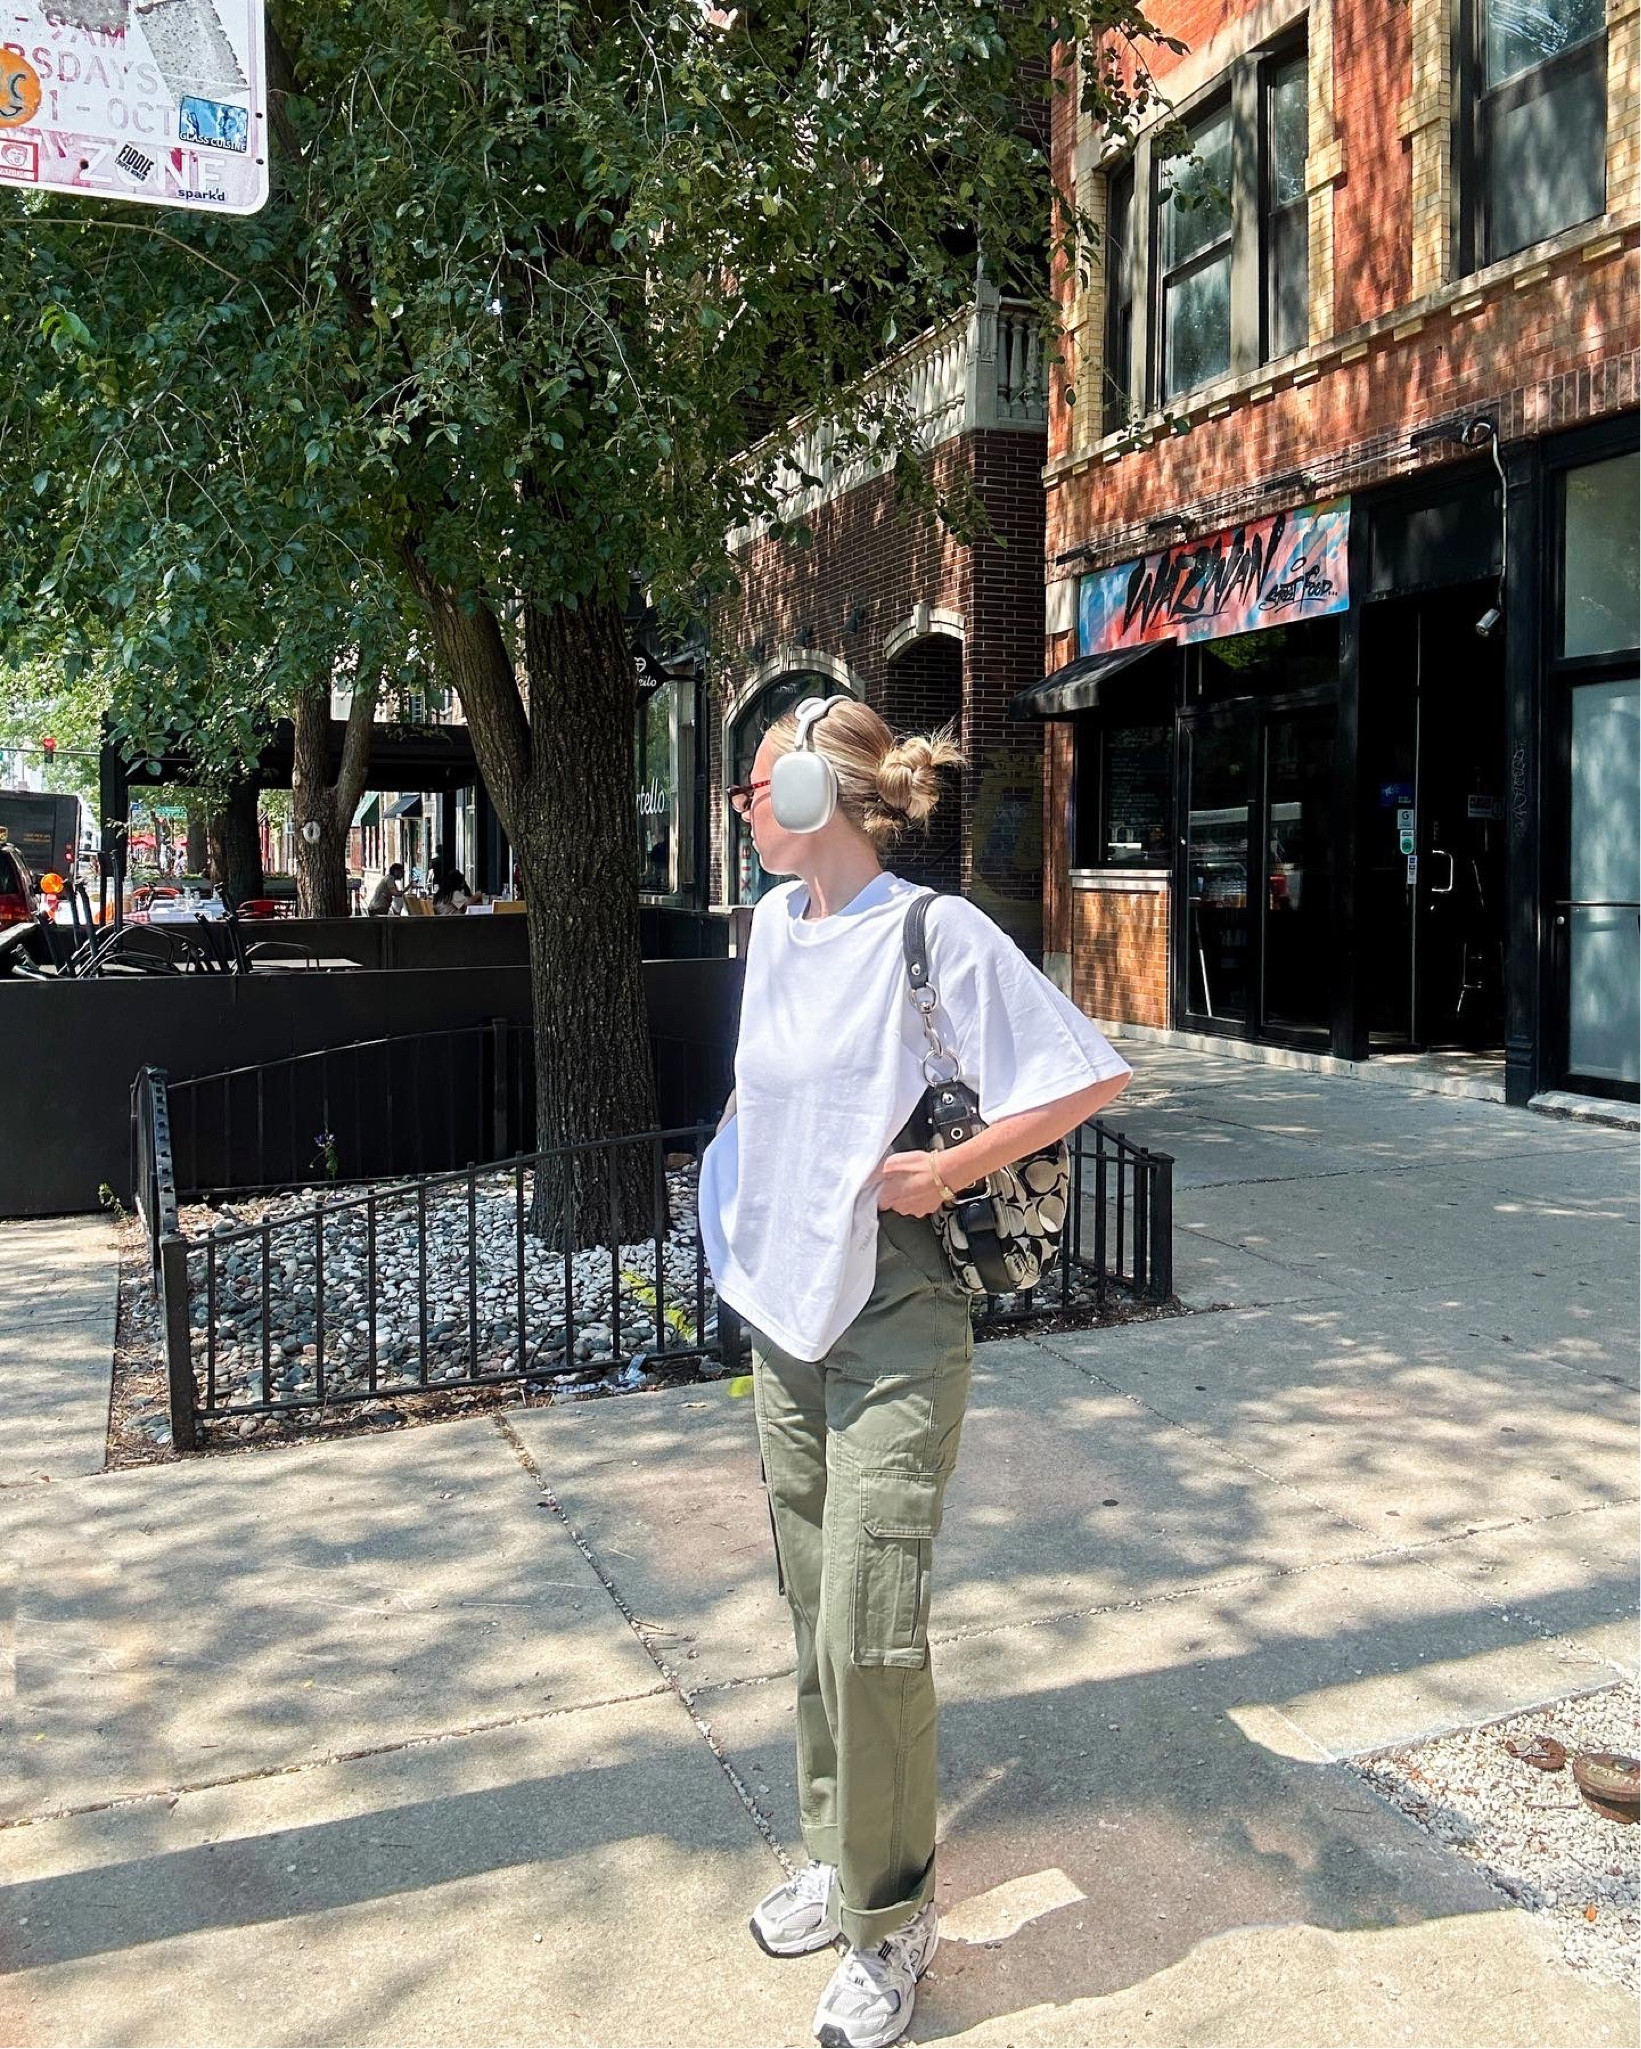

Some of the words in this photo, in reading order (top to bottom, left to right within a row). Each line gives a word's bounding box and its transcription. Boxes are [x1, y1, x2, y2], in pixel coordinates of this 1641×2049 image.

[107, 97, 175, 136] OCT
[180, 131, 209, 144] GLASS
[210, 137, 247, 152] CUISINE
[178, 188, 225, 201] spark'd
